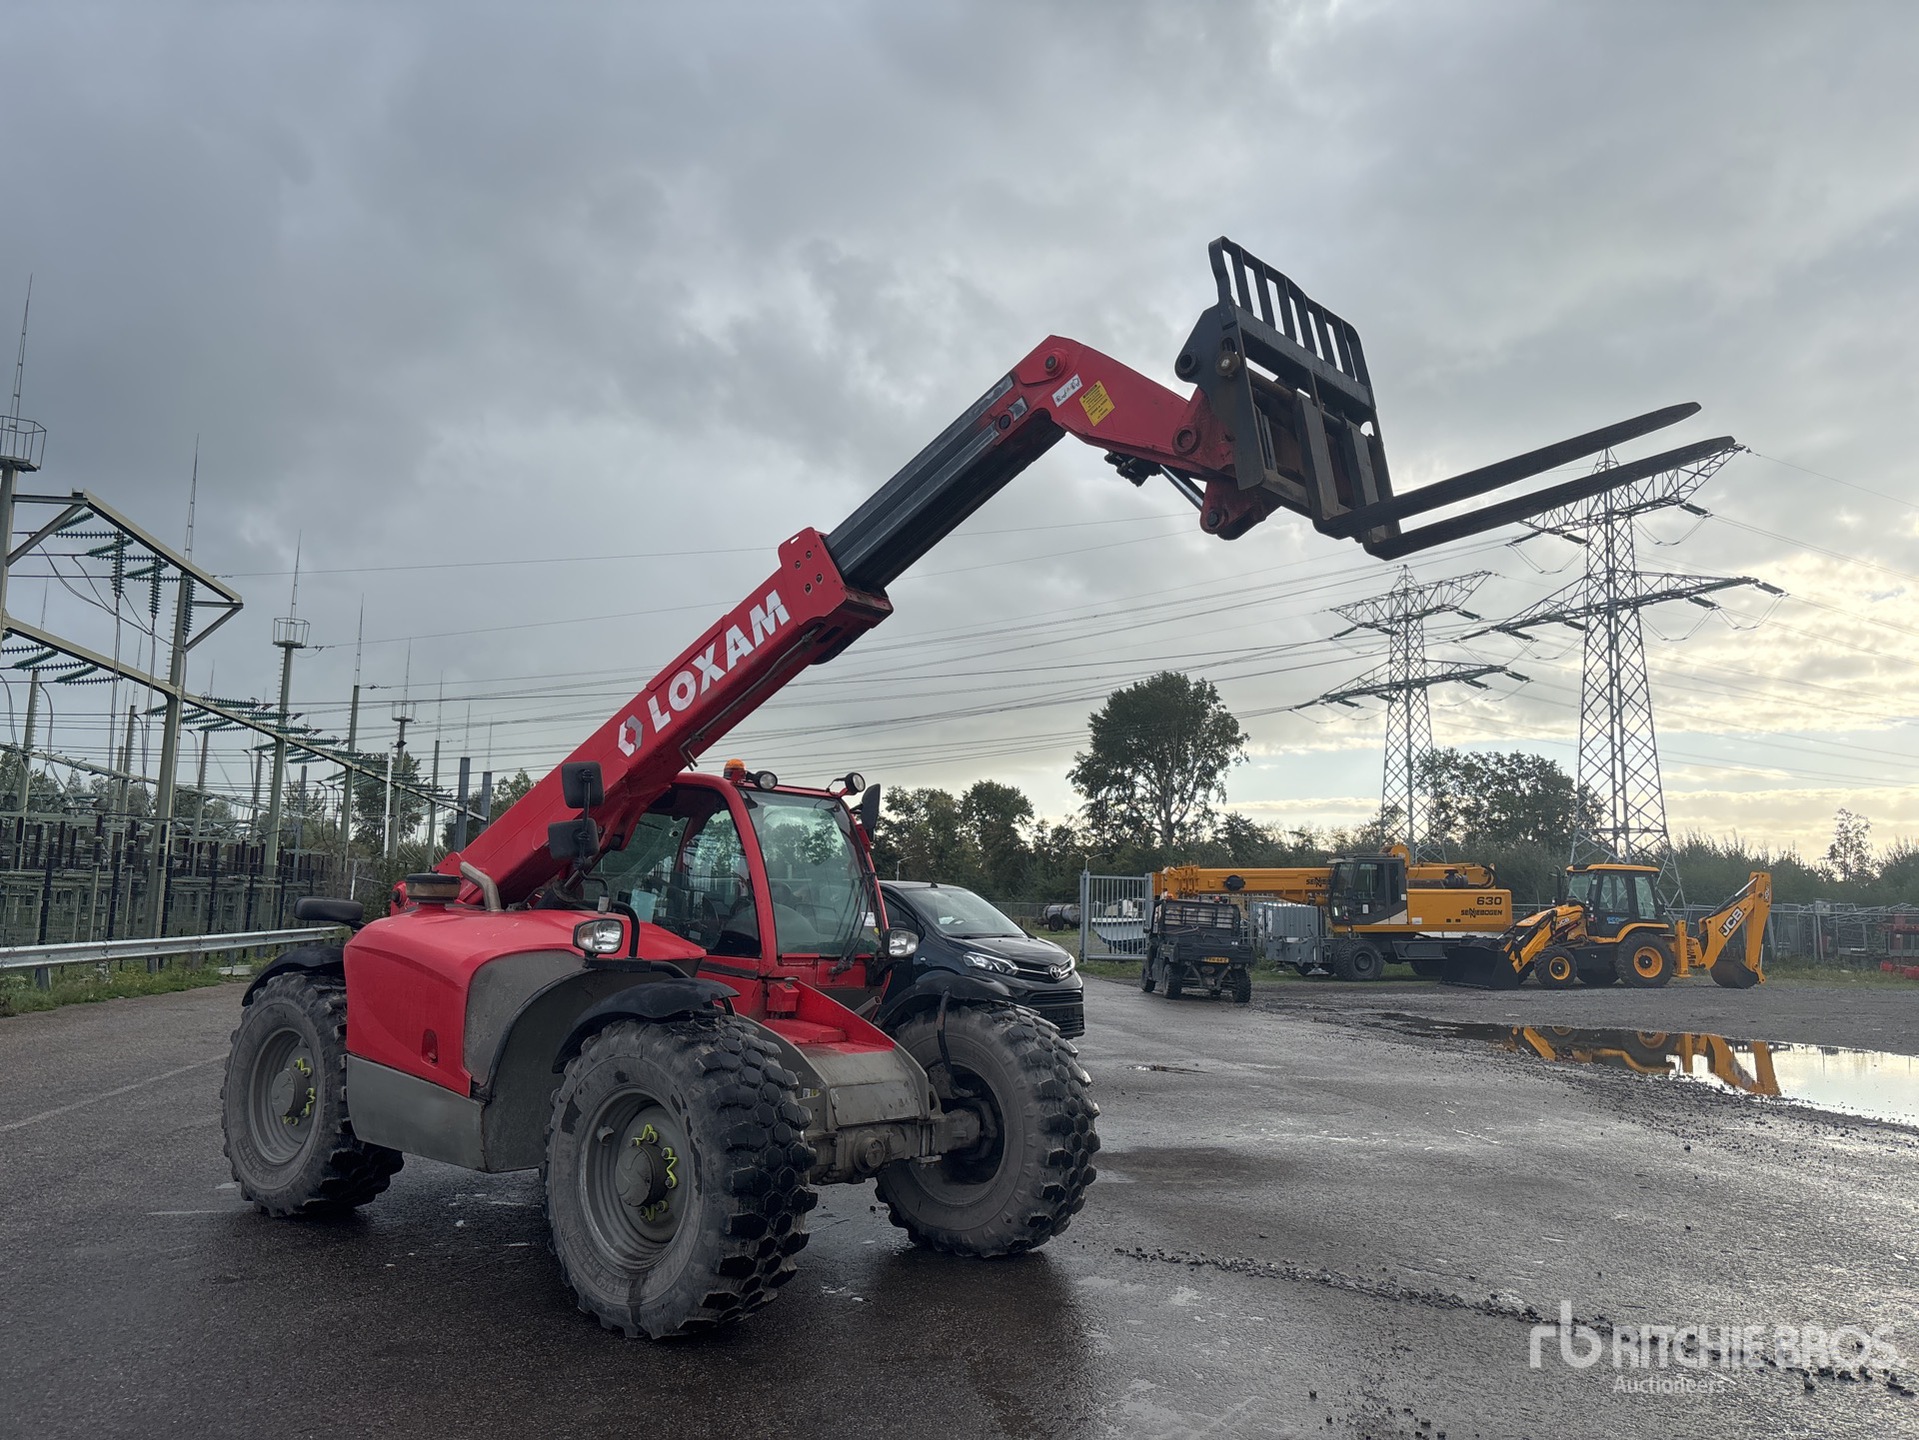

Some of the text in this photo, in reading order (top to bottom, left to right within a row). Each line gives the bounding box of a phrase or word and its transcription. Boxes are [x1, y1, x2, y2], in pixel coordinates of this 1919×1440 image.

[647, 589, 791, 734] LOXAM
[1476, 896, 1503, 906] 630
[1722, 907, 1744, 936] JCB
